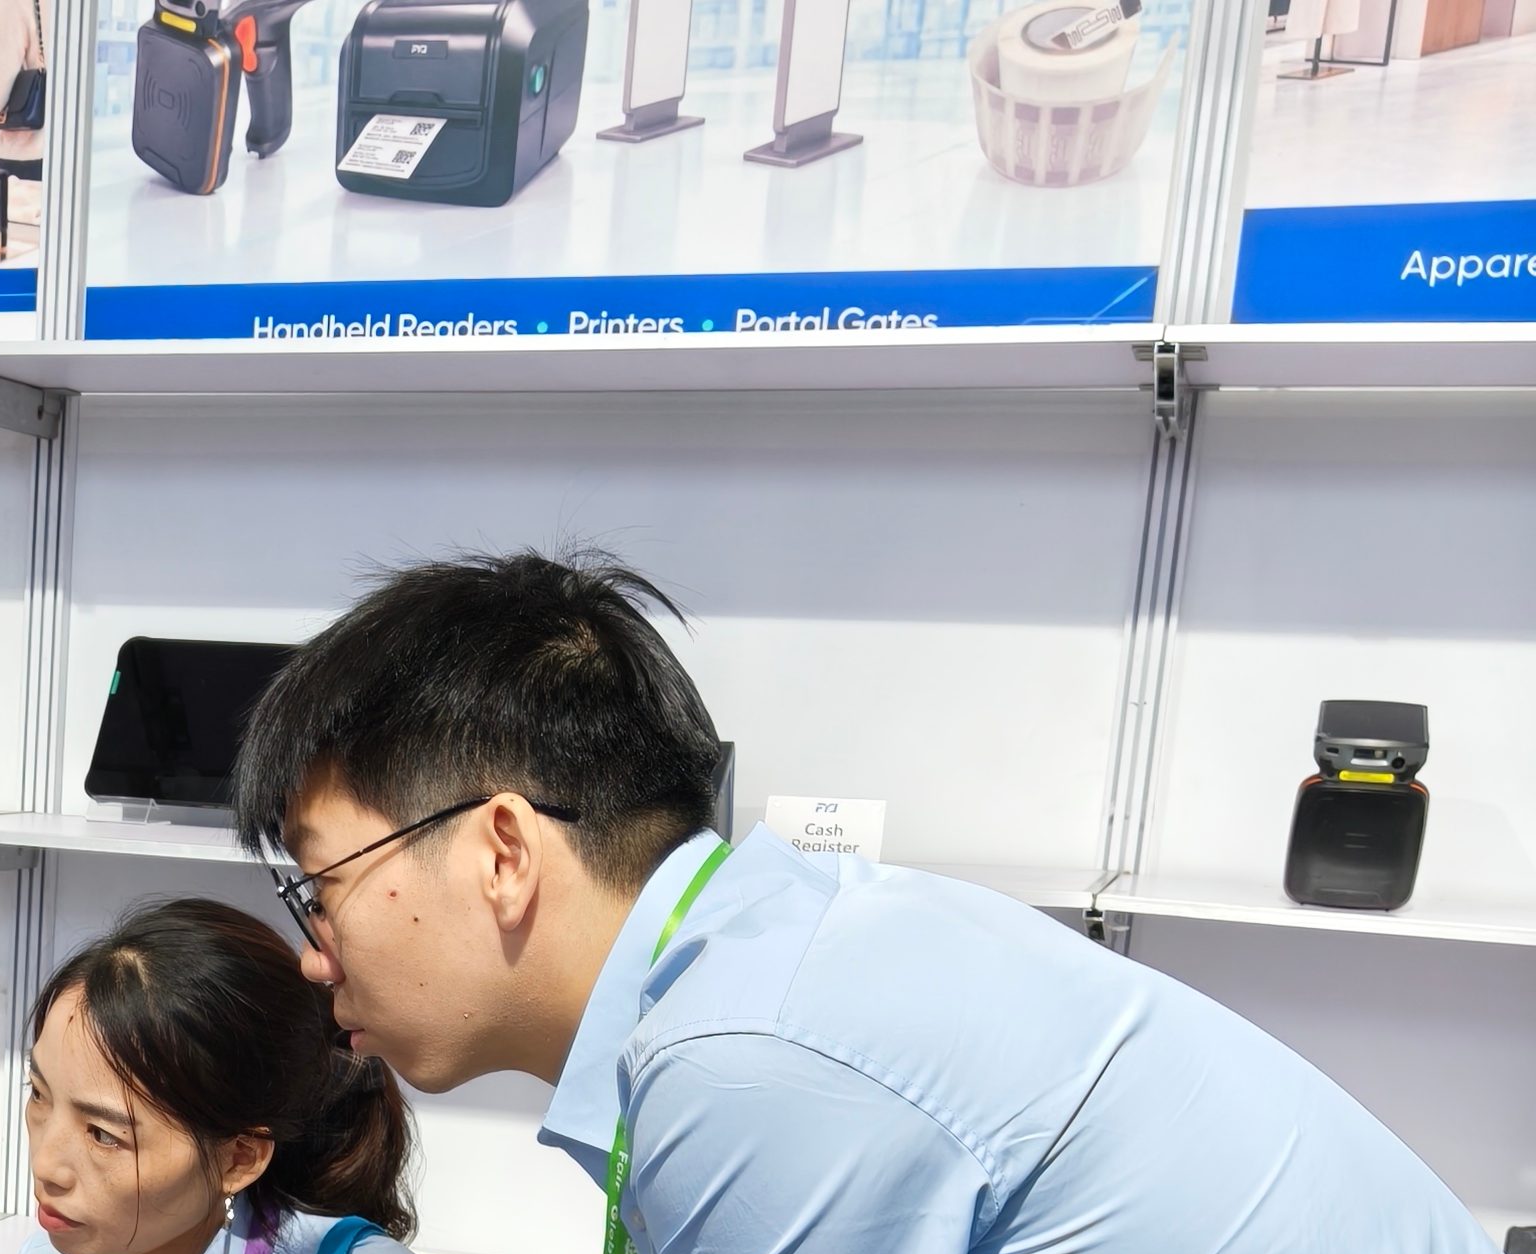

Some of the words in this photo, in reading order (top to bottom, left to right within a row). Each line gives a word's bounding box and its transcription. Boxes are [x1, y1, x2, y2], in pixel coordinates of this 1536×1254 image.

[253, 313, 391, 338] Handheld
[398, 312, 517, 337] Readers
[569, 311, 684, 334] Printers
[735, 308, 829, 332] Portal
[837, 307, 938, 330] Gates
[805, 823, 843, 837] Cash
[791, 838, 860, 854] Register
[615, 1151, 629, 1192] Fair
